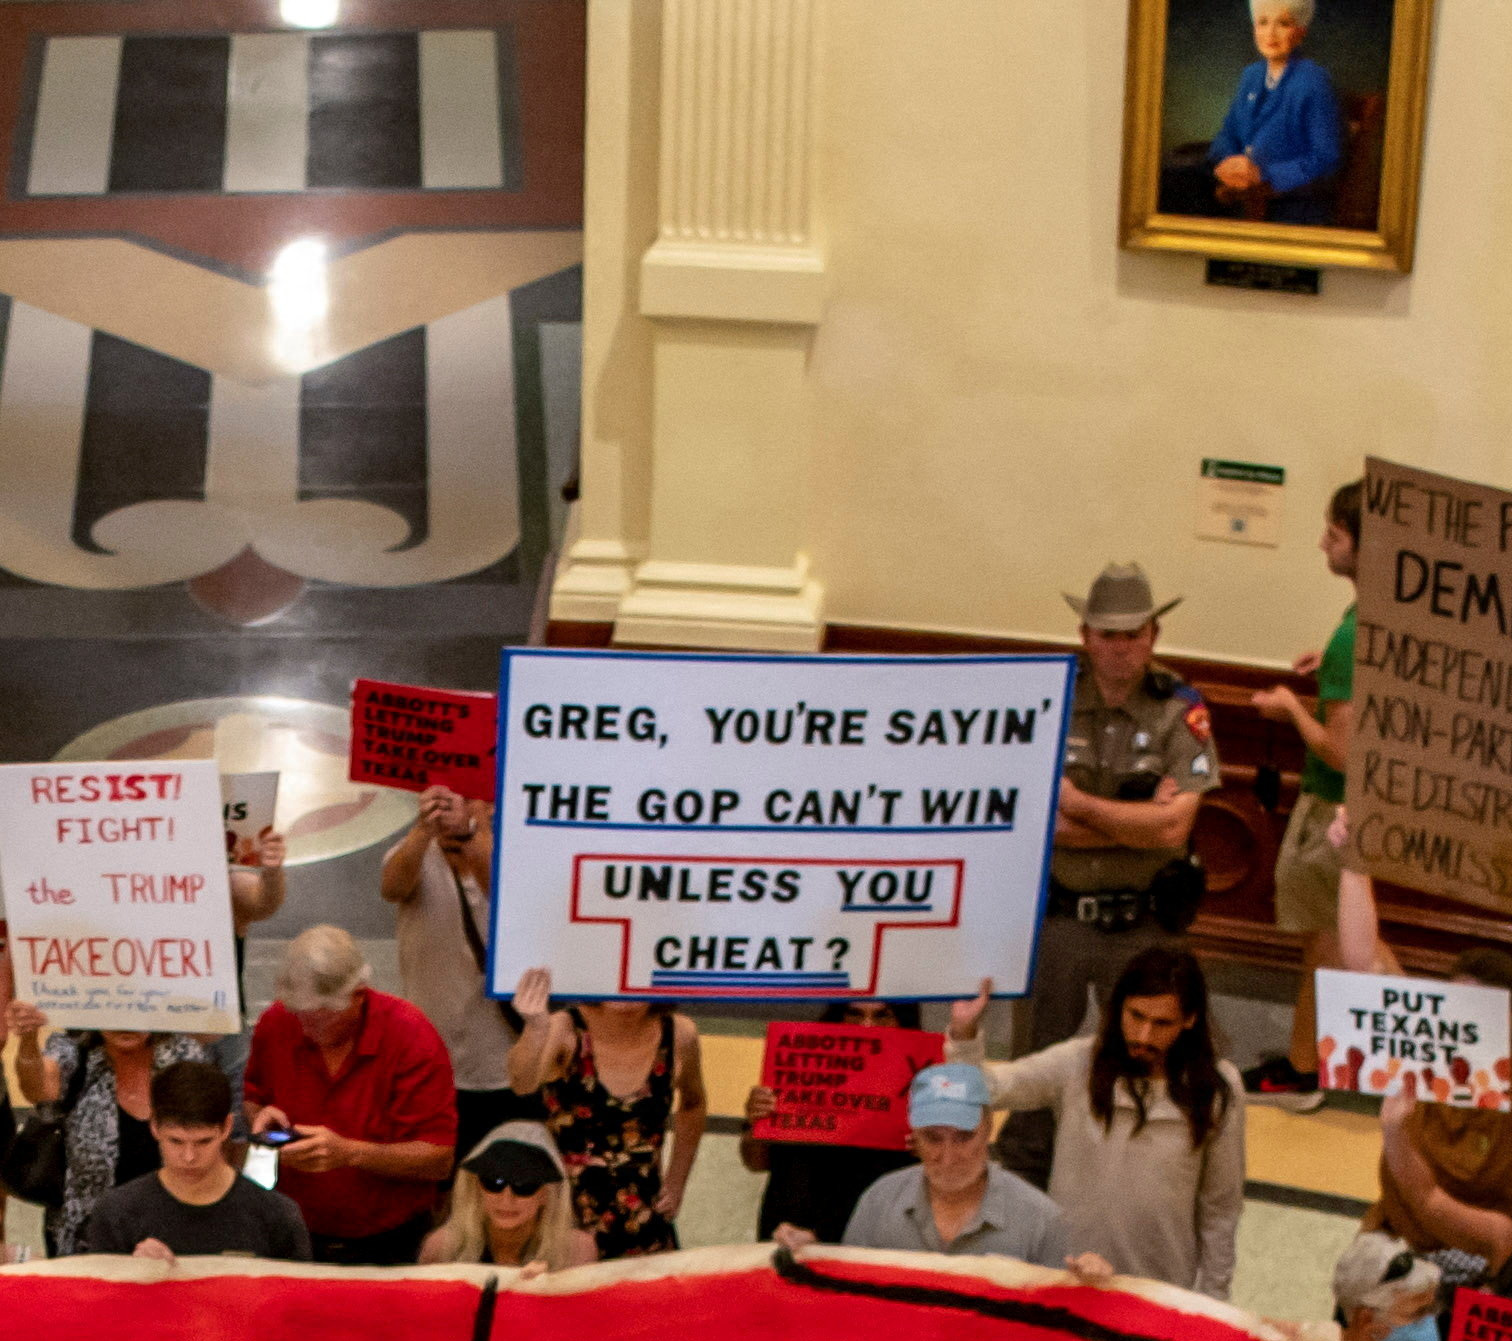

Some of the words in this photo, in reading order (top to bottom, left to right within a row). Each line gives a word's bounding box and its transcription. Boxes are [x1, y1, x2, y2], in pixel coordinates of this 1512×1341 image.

[1364, 475, 1420, 526] WE
[1417, 487, 1483, 549] THE
[523, 704, 668, 750] GREG,
[705, 701, 867, 746] YOU'RE
[886, 697, 1051, 746] SAYIN'
[32, 774, 183, 805] RESIST!
[523, 784, 611, 821] THE
[637, 791, 740, 825] GOP
[764, 783, 903, 825] CAN'T
[920, 788, 1019, 825] WIN
[58, 816, 176, 844] FIGHT!
[25, 878, 75, 906] the
[103, 873, 205, 904] TRUMP
[603, 865, 801, 902] UNLESS
[836, 869, 935, 903] YOU
[20, 935, 212, 978] TAKEOVER!
[1382, 988, 1445, 1013] PUT
[1348, 1008, 1479, 1044] TEXANS
[1371, 1036, 1458, 1064] FIRST
